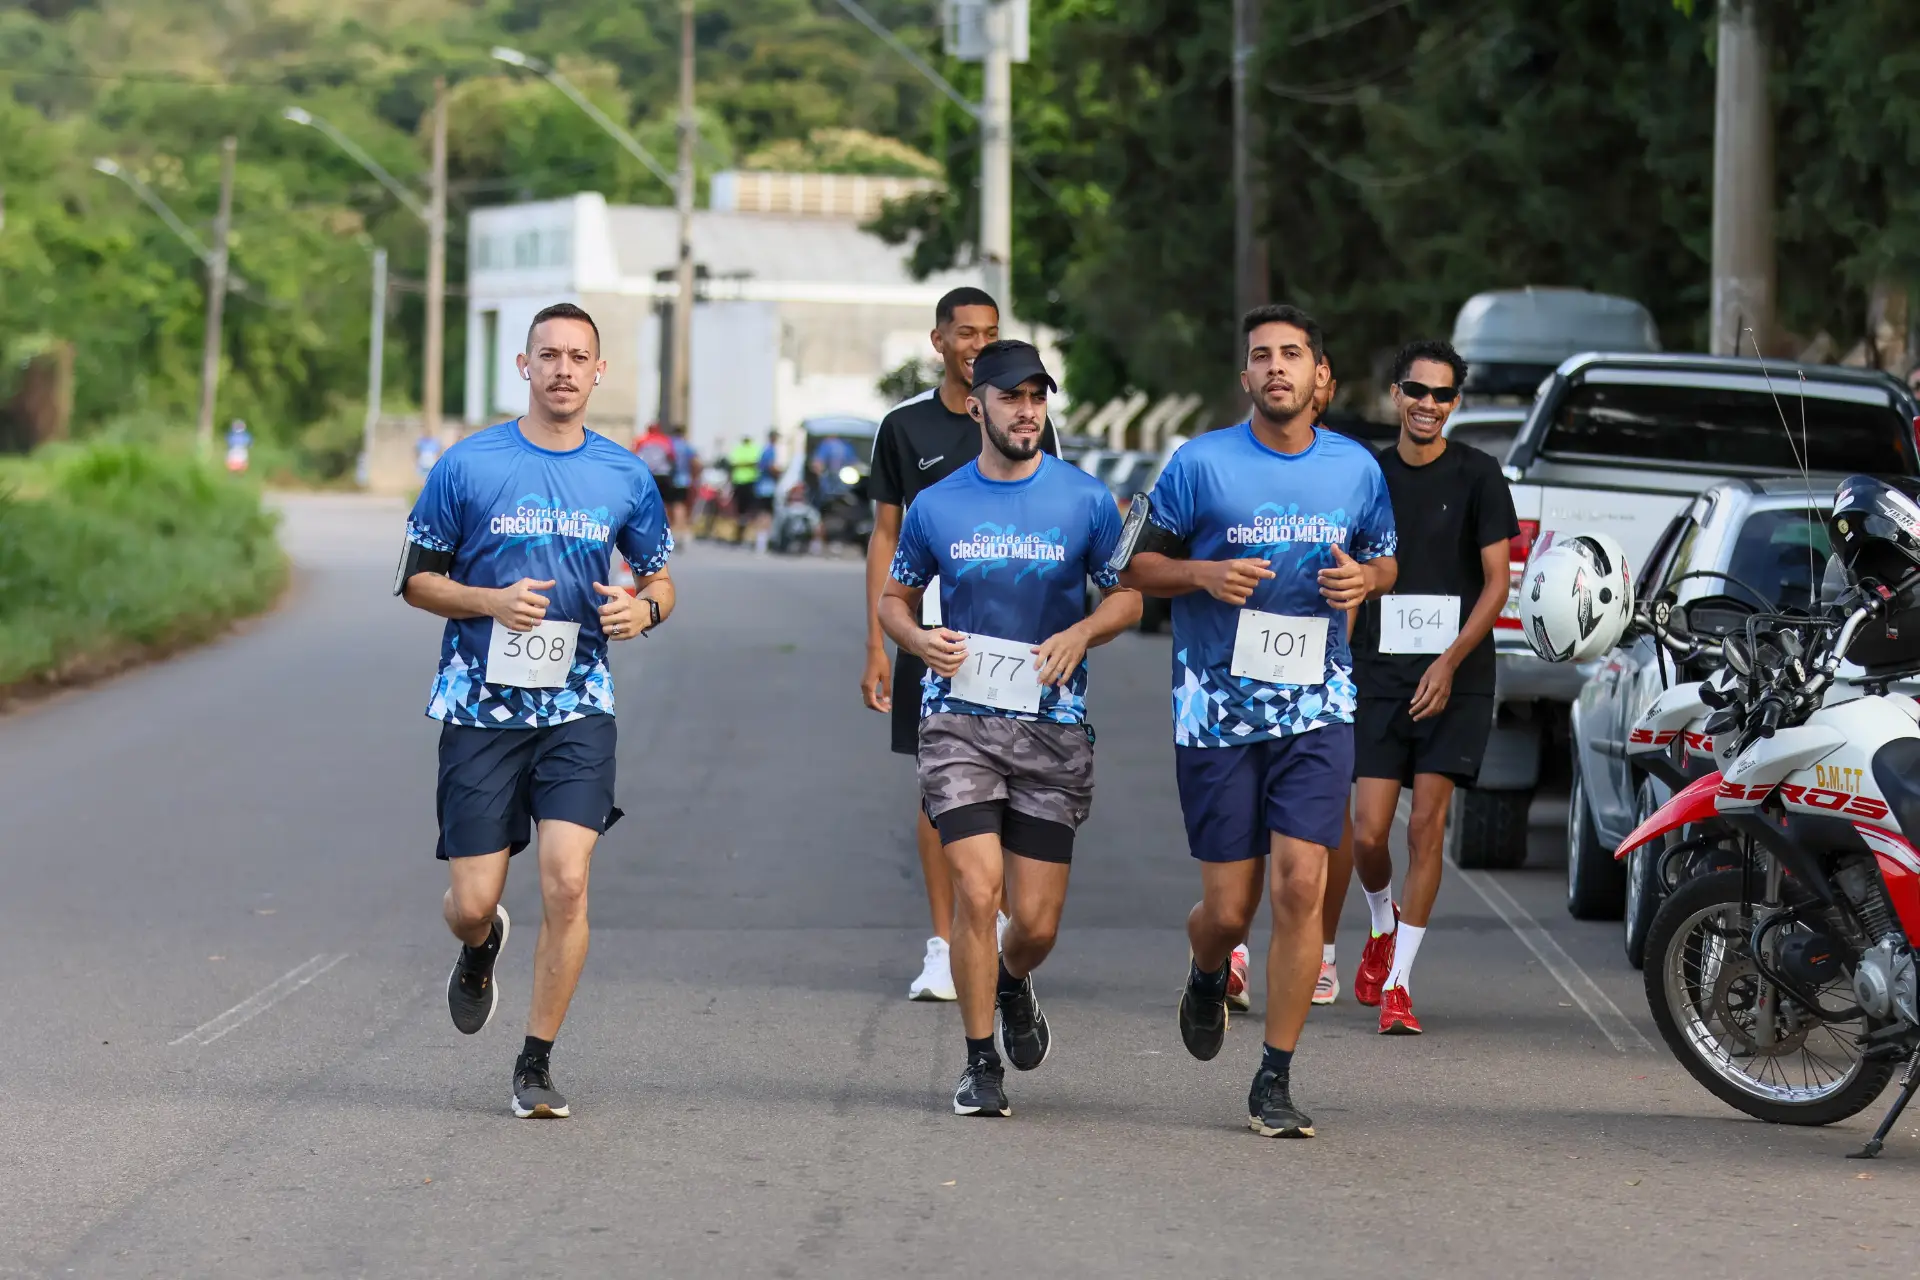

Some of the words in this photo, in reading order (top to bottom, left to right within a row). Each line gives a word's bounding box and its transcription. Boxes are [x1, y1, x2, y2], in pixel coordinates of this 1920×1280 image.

[516, 506, 567, 519] Corrida
[571, 510, 588, 522] do
[1253, 514, 1305, 527] Corrida
[1308, 515, 1326, 526] do
[490, 513, 554, 535] CÍRCULO
[556, 518, 611, 543] MILITAR
[973, 532, 1021, 544] Corrida
[1024, 534, 1041, 544] do
[1226, 523, 1291, 544] CÍRCULO
[1294, 525, 1348, 544] MILITAR
[950, 539, 1009, 560] CÍRCULO
[1011, 542, 1066, 562] MILITAR
[1396, 608, 1444, 630] 164
[503, 631, 566, 662] 308
[1260, 629, 1307, 658] 101
[974, 651, 1026, 682] 177
[1715, 779, 1889, 820] BROS
